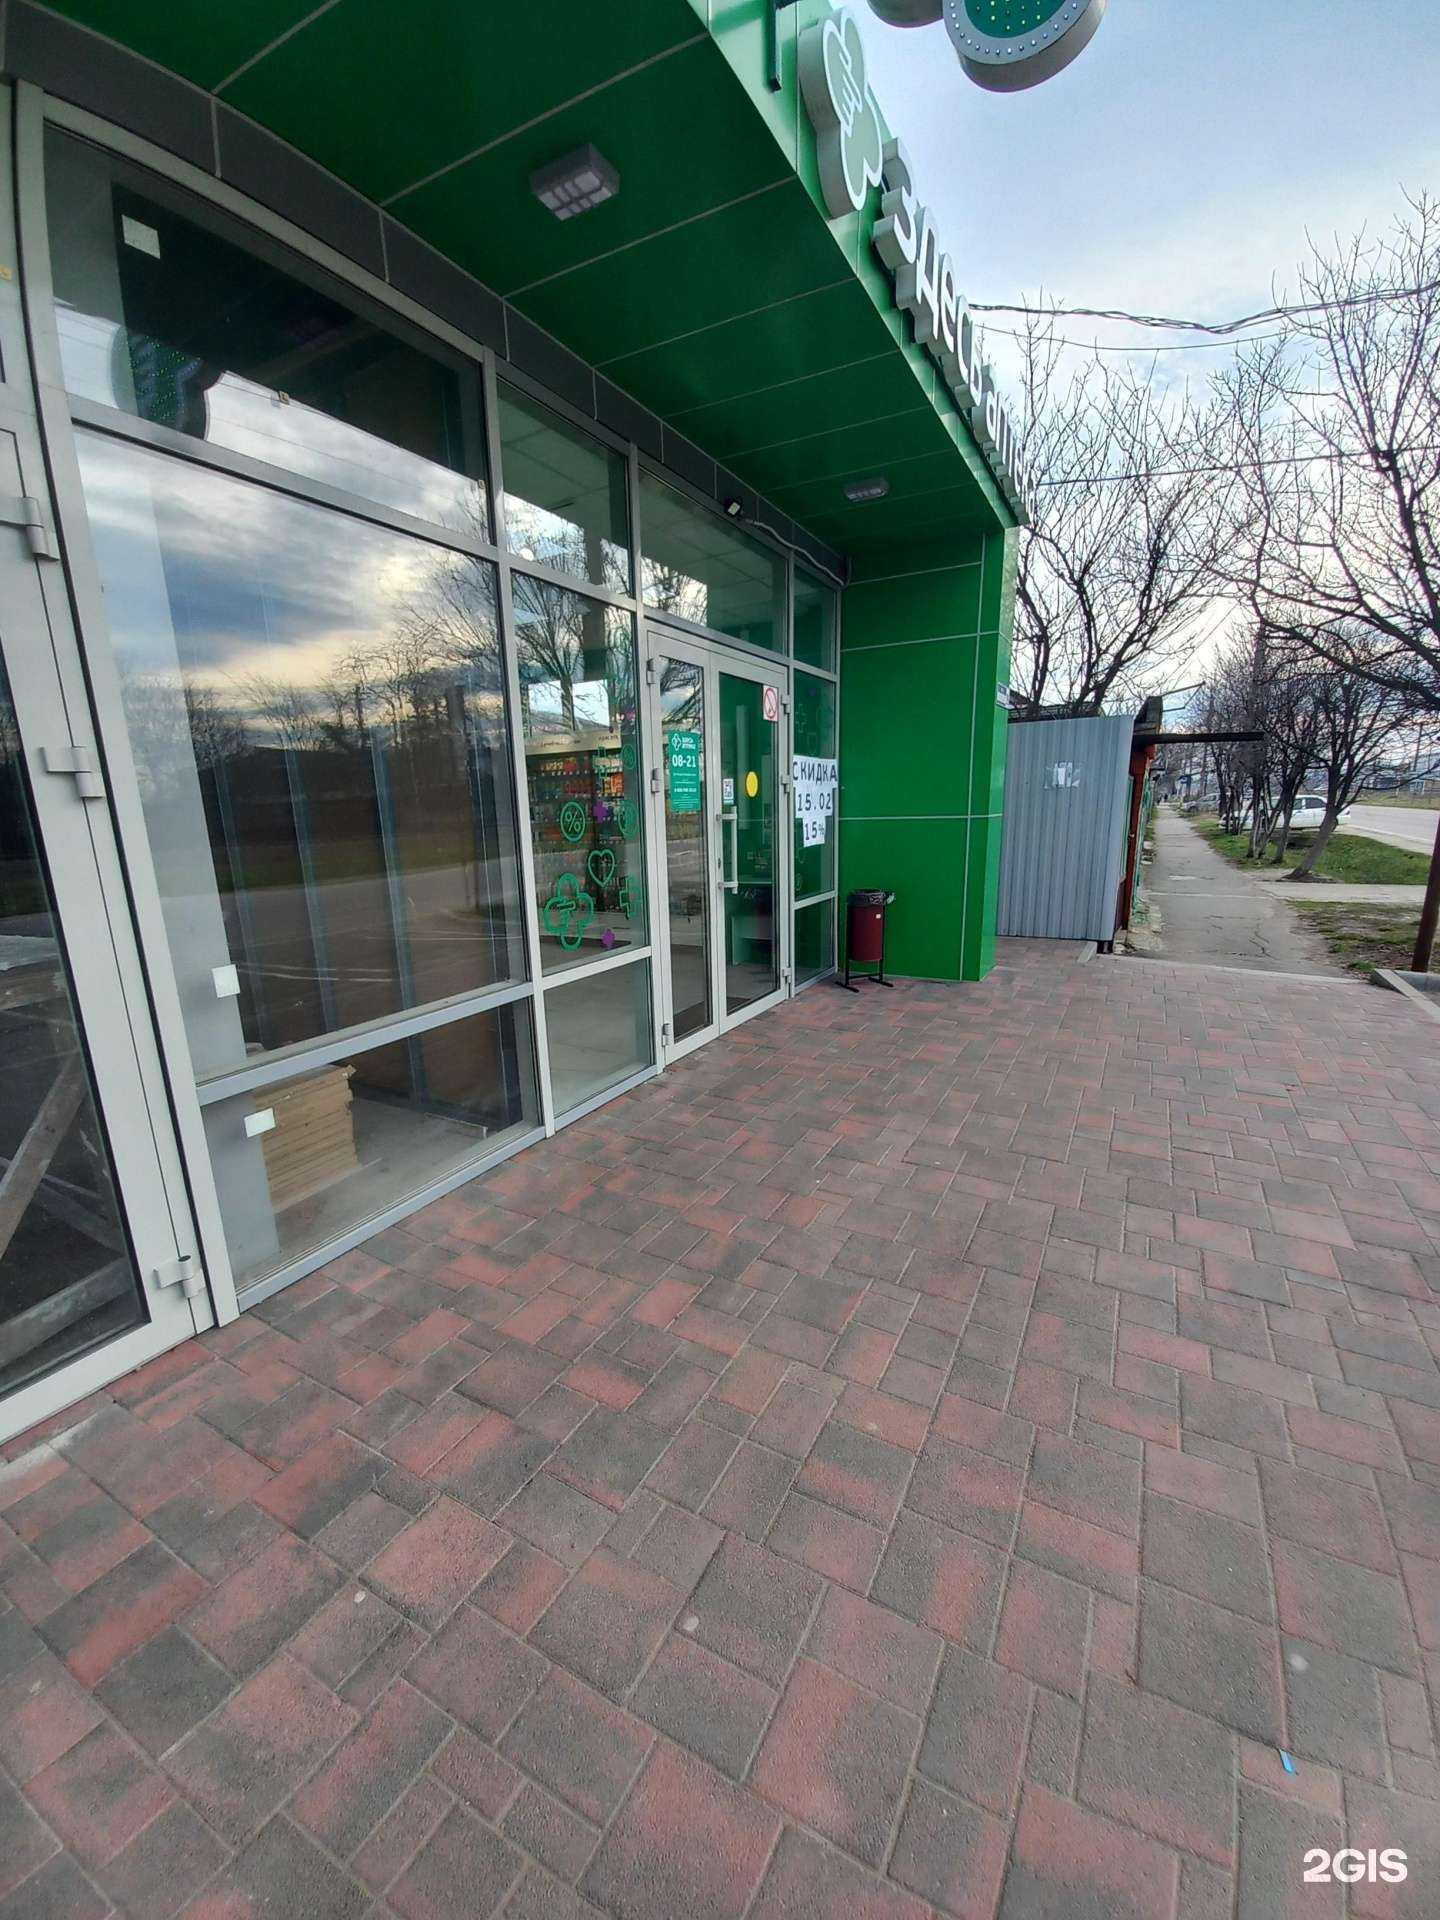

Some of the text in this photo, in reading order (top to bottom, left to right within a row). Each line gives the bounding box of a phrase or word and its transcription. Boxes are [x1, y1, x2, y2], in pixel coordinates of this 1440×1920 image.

[672, 754, 696, 768] 08-21
[792, 761, 838, 785] СКИДКА
[797, 793, 831, 811] 15.02
